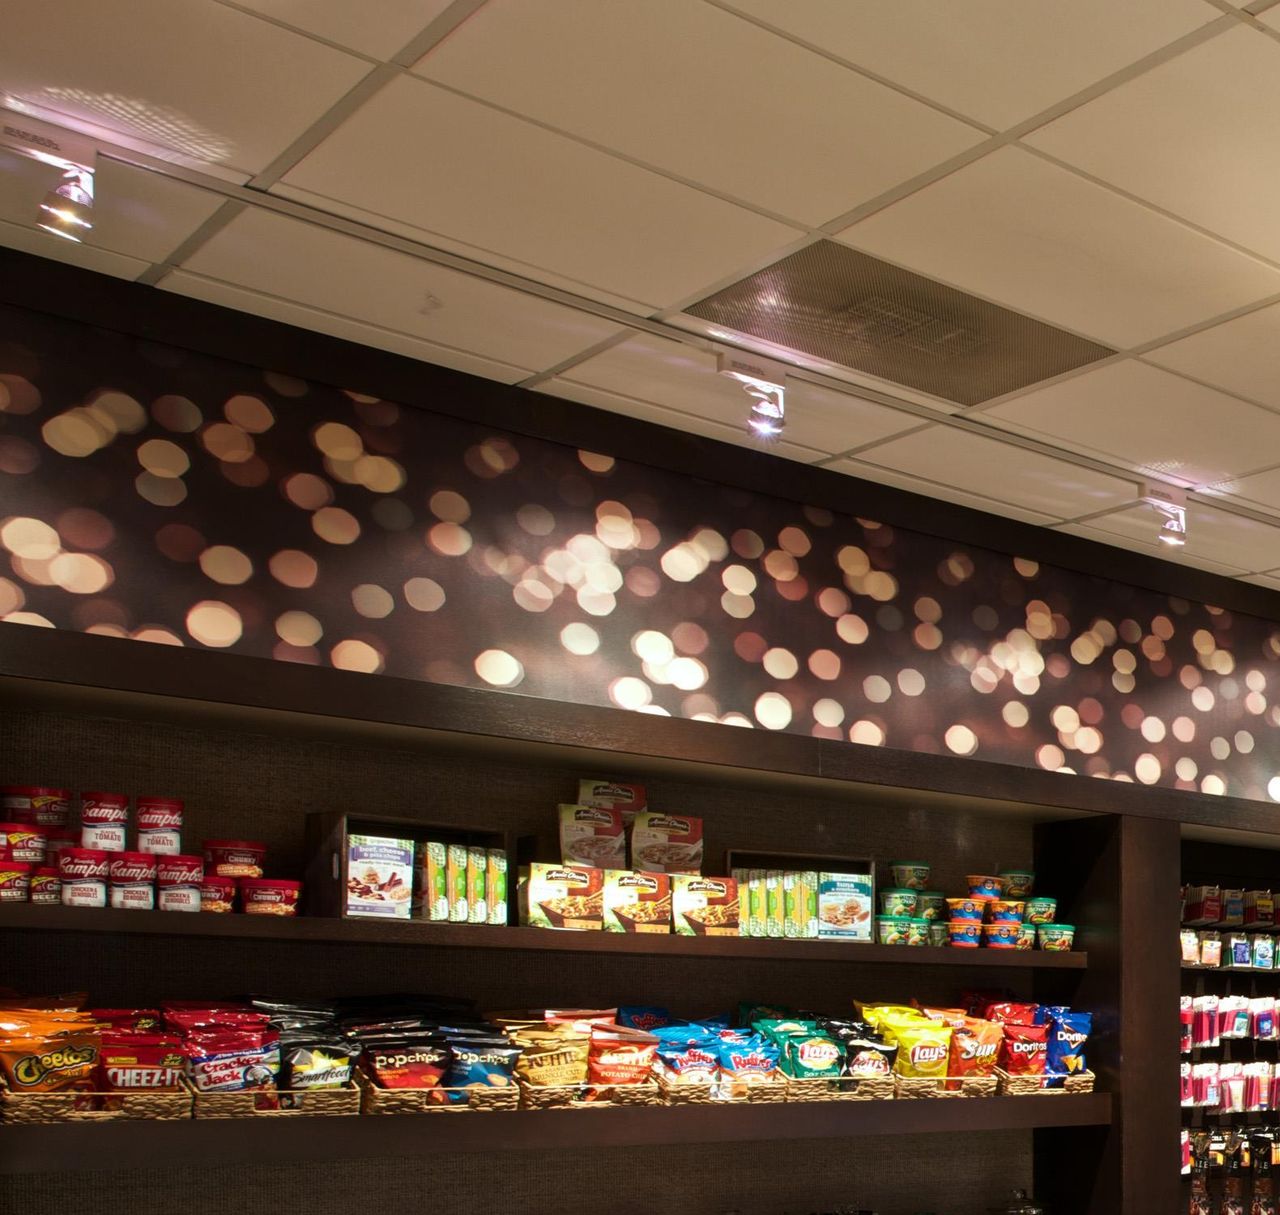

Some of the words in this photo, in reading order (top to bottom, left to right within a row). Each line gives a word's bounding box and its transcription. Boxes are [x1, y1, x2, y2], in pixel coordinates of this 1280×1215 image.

[95, 834, 122, 842] TOMATO
[147, 838, 174, 846] TOMATO
[913, 1044, 947, 1063] Lay's
[962, 1041, 997, 1060] Sun
[1013, 1042, 1048, 1053] Doritos
[13, 1047, 96, 1086] Cheetos
[200, 1055, 263, 1074] Cracker
[375, 1052, 440, 1069] popchips
[107, 1068, 181, 1087] CHEEZ-IT
[200, 1071, 241, 1087] Jack
[291, 1068, 350, 1085] Smartfood
